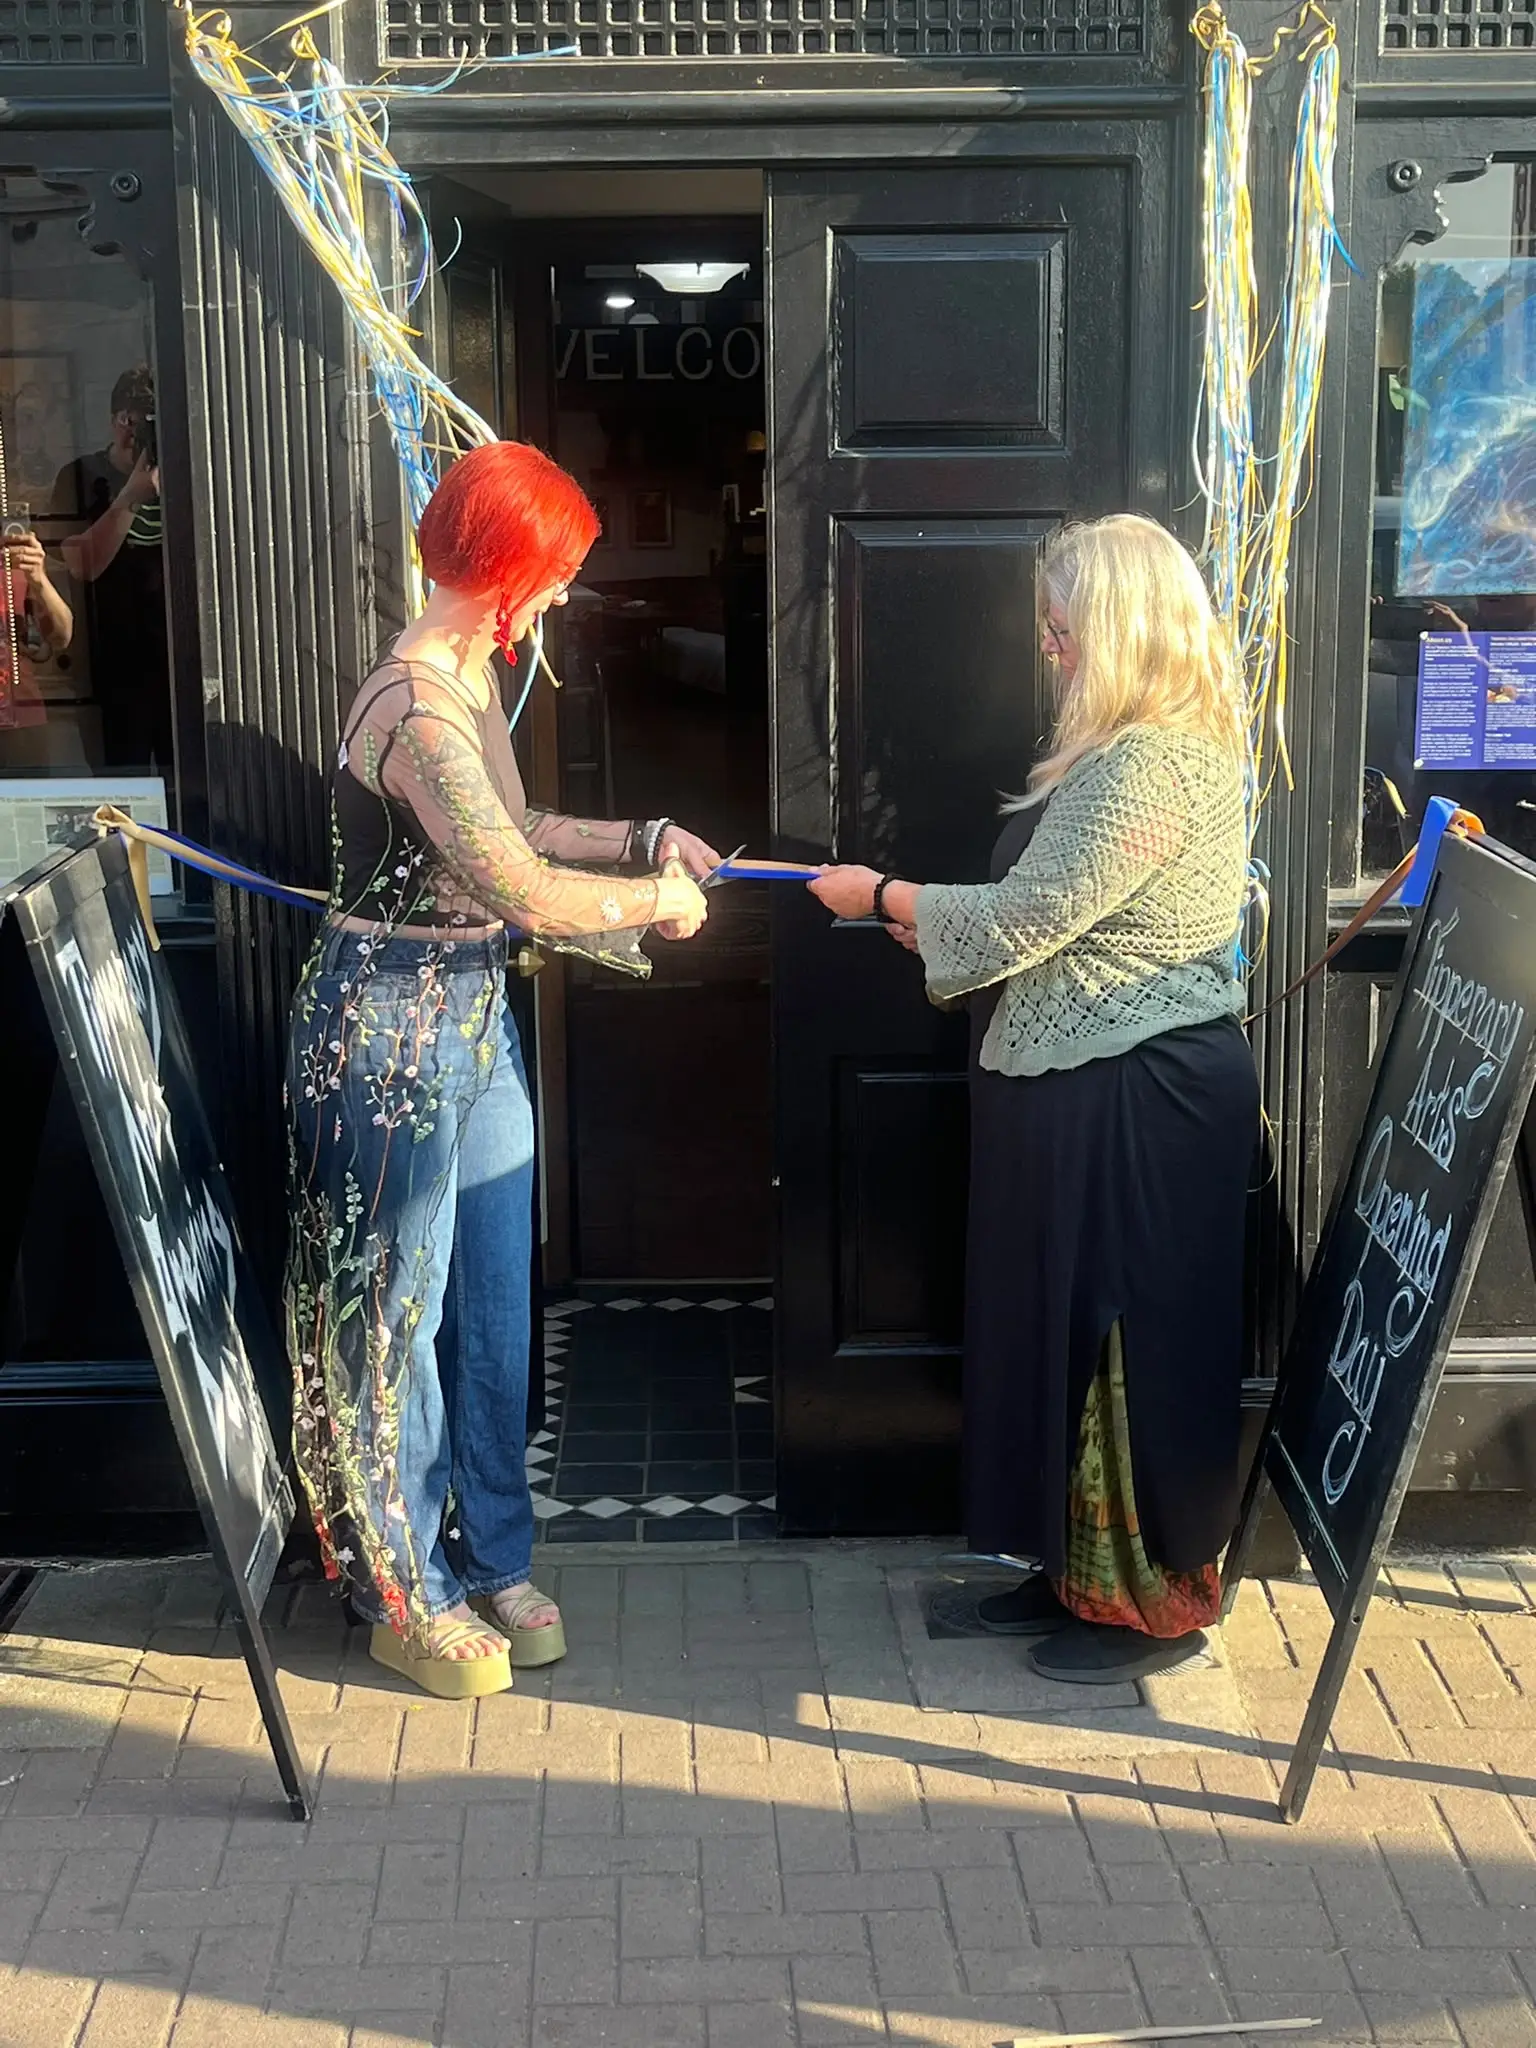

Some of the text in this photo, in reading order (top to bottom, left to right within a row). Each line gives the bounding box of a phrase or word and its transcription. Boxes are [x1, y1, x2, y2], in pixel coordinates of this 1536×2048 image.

[55, 914, 162, 1087] Tipperary
[1412, 907, 1524, 1119] Tipperary
[115, 1044, 179, 1217] Arts
[1401, 1050, 1465, 1172] Arts
[138, 1180, 235, 1345] Opening
[1355, 1114, 1452, 1358] Opening
[1322, 1279, 1387, 1505] Day
